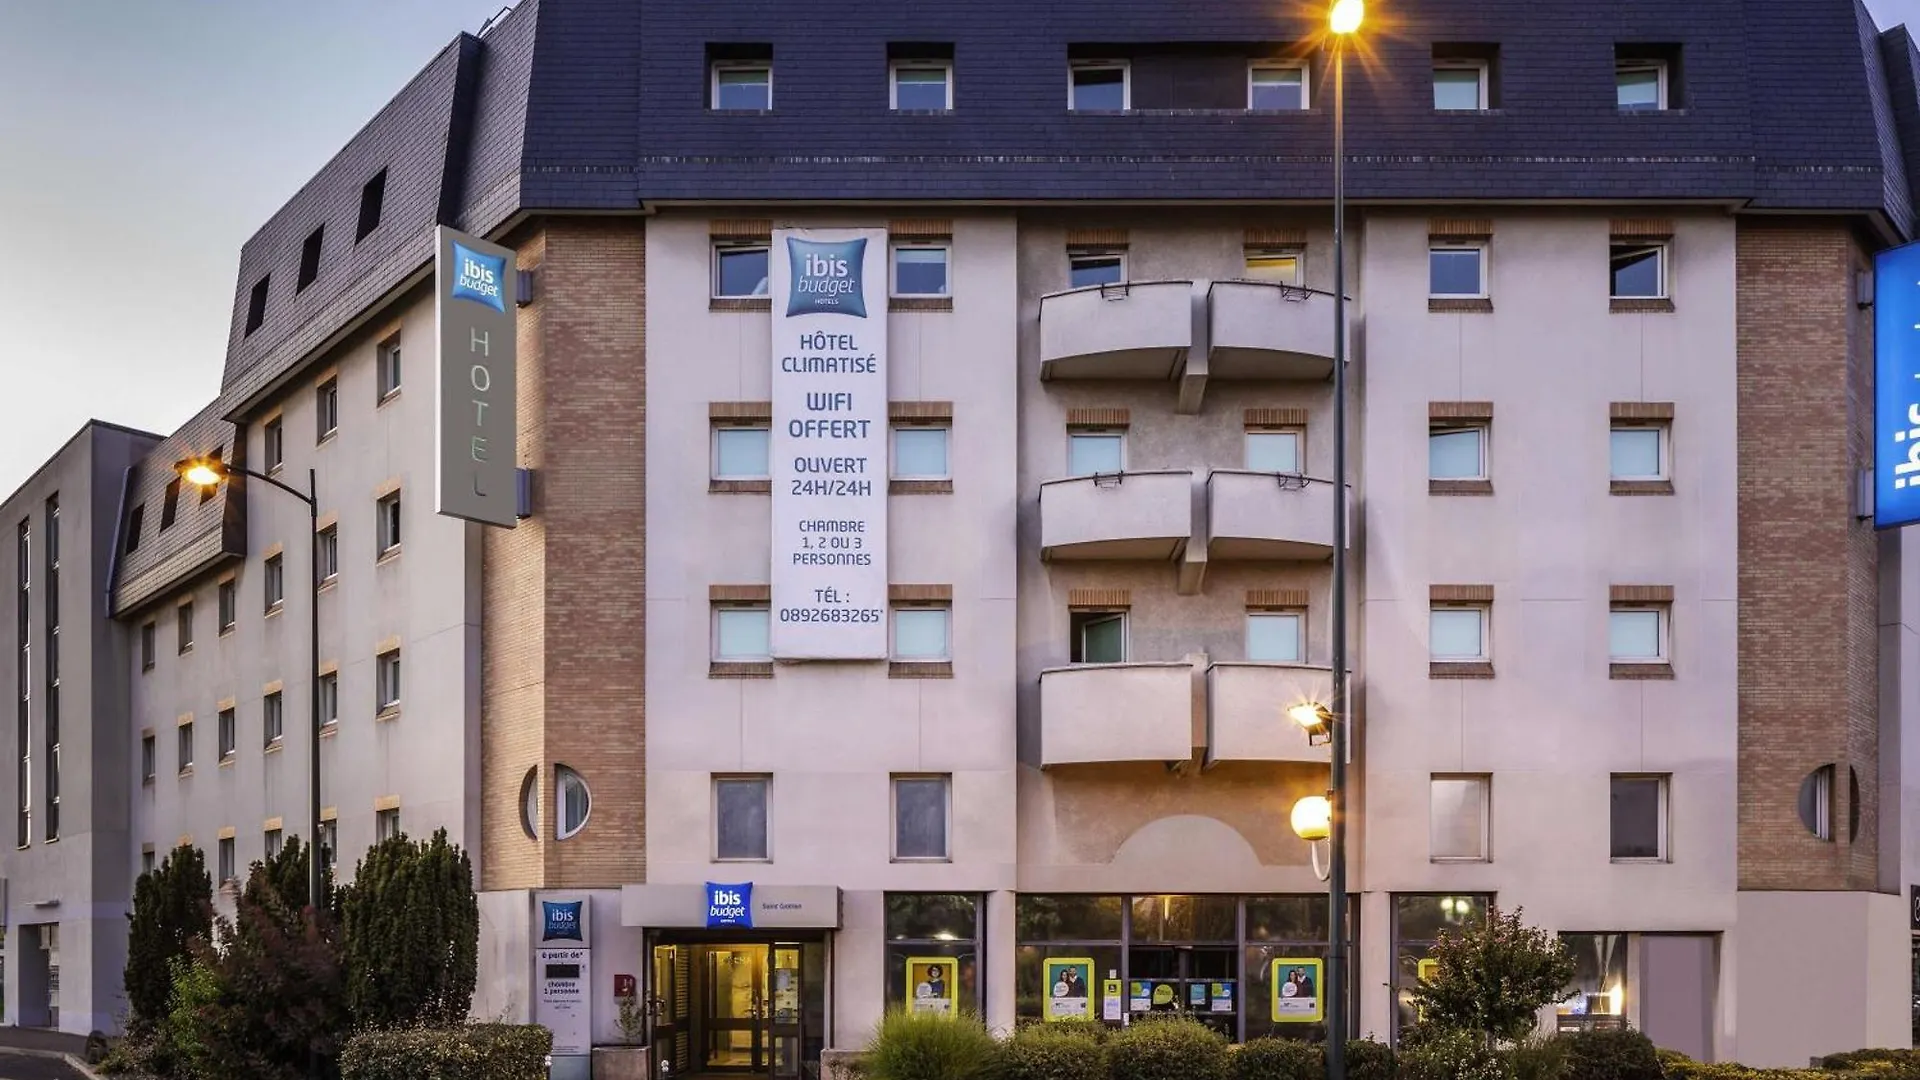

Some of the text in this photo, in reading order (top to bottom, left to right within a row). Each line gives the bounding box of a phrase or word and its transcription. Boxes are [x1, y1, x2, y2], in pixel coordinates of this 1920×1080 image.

[464, 257, 494, 284] ibis
[805, 253, 849, 277] ibis
[460, 273, 499, 297] budget
[798, 275, 856, 297] budget
[800, 331, 858, 351] HÔTEL
[782, 353, 876, 373] CLIMATISÉ
[806, 392, 852, 411] WIFI
[470, 326, 491, 497] HOTEL
[788, 419, 871, 438] OFFERT
[794, 457, 867, 474] OUVERT
[791, 480, 872, 496] 24H/24H
[799, 520, 865, 532] CHAMBRE
[802, 537, 863, 550] 1, 2 OU 3
[793, 553, 871, 566] PERSONNES
[815, 587, 842, 603] TÉL
[714, 890, 741, 905] ibis
[552, 909, 574, 922] ibis
[710, 905, 746, 919] budget
[548, 952, 569, 960] partir
